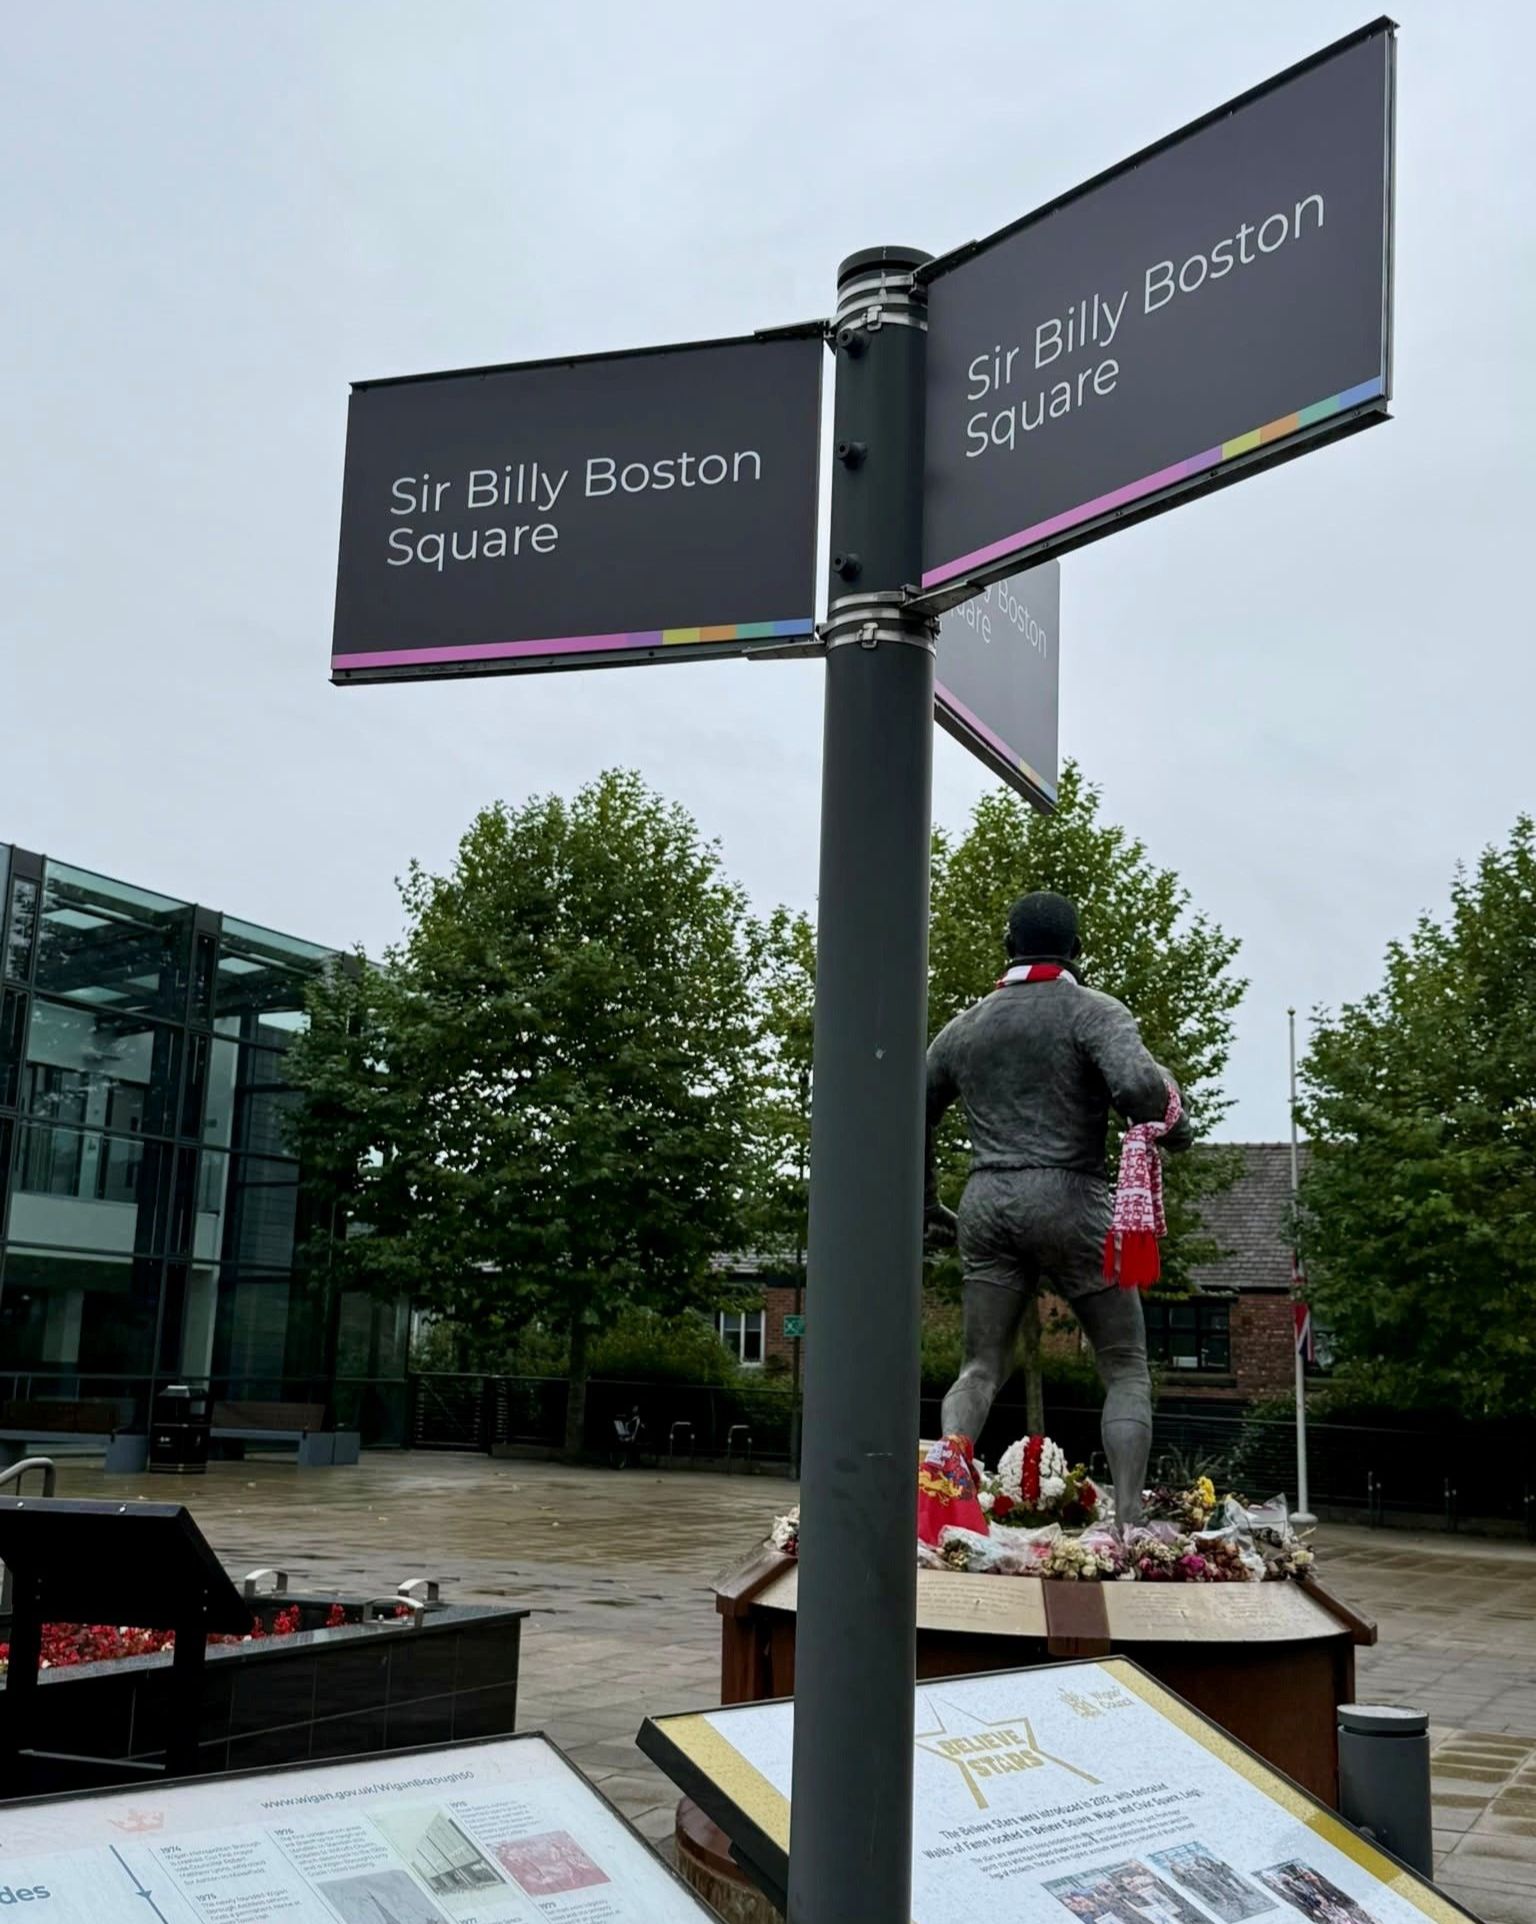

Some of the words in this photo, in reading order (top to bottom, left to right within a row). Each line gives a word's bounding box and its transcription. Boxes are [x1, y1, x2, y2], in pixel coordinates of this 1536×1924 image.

[967, 345, 1019, 401] Sir
[1035, 291, 1128, 369] Billy
[1144, 194, 1324, 315] Boston
[965, 358, 1120, 457] Square
[390, 473, 451, 515] Sir
[468, 462, 569, 511] Billy
[585, 451, 761, 497] Boston
[387, 523, 559, 572] Square
[999, 580, 1047, 659] Boston
[936, 1729, 1026, 1756] BELIEVE
[967, 1750, 1044, 1777] STARS
